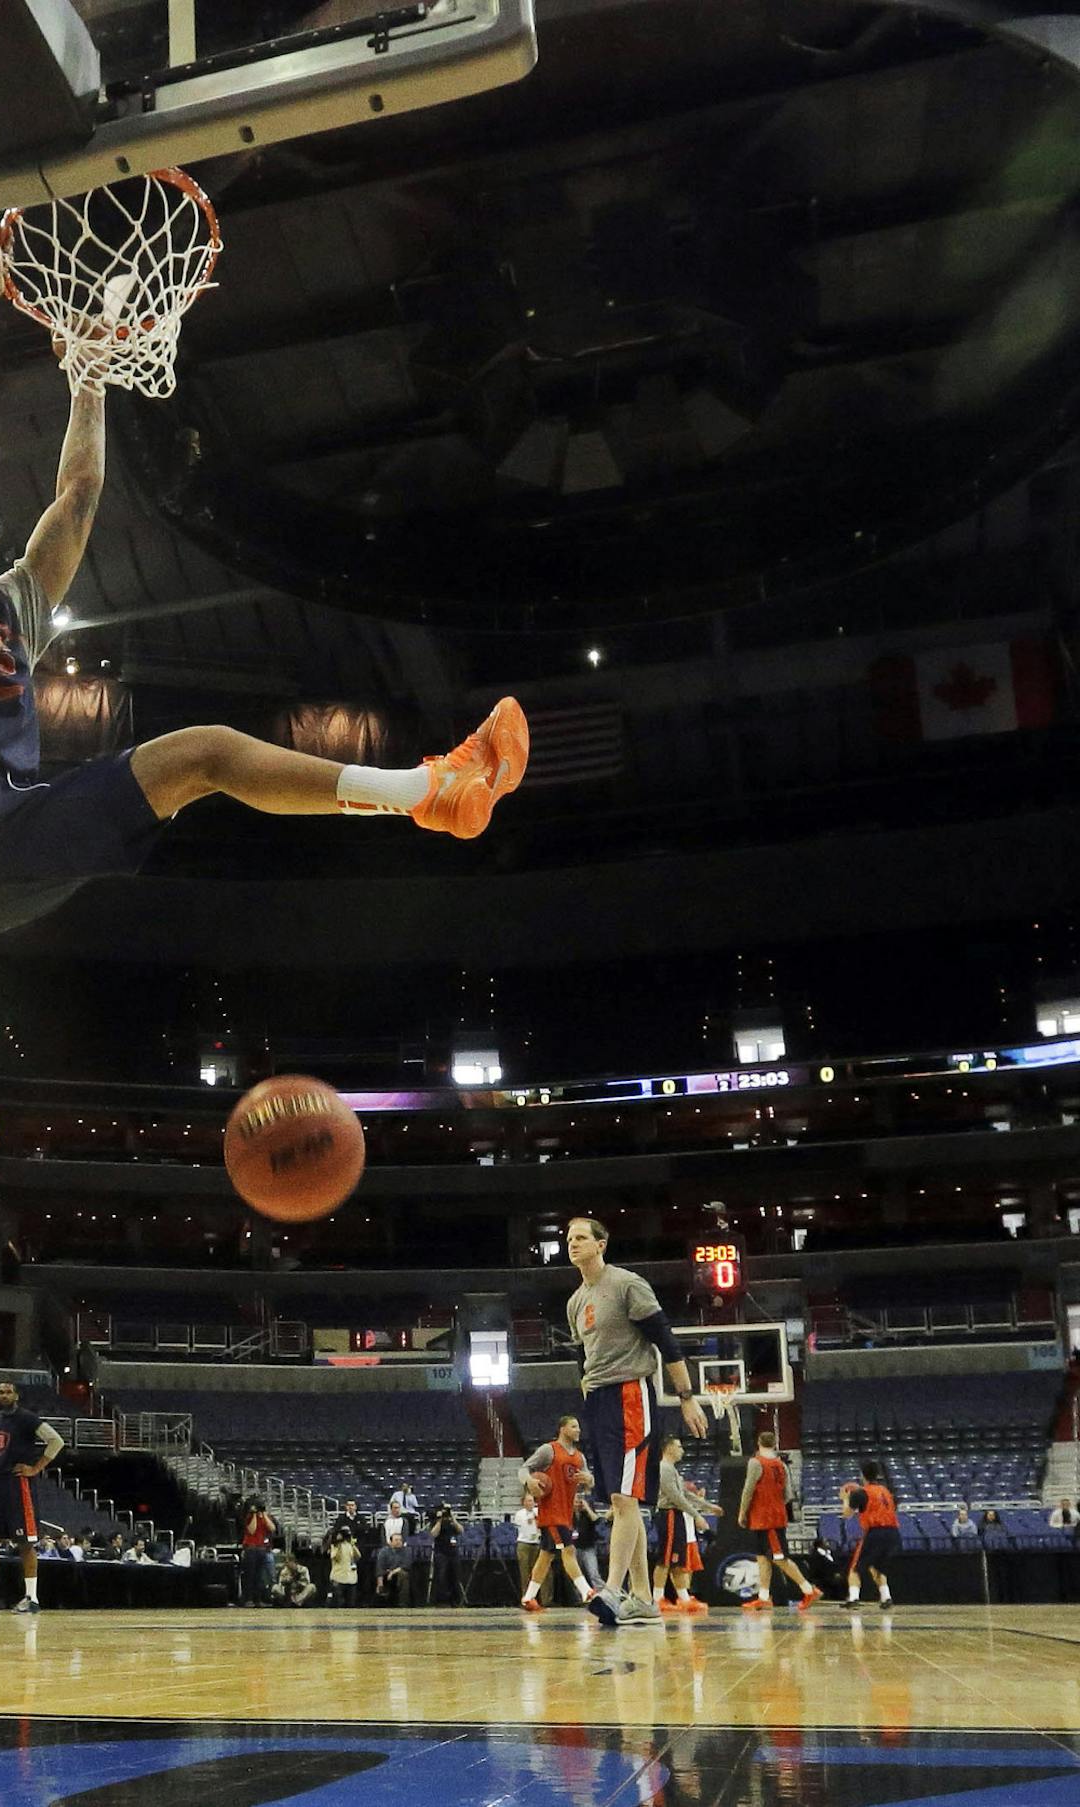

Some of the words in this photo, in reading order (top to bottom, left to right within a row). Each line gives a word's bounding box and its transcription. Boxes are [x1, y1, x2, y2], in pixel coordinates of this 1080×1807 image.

[738, 1071, 789, 1089] 23:03
[820, 1066, 834, 1082] 0
[662, 1079, 676, 1094] 0
[695, 1245, 737, 1262] 23:03
[717, 1261, 734, 1288] 0
[432, 1367, 453, 1379] 107
